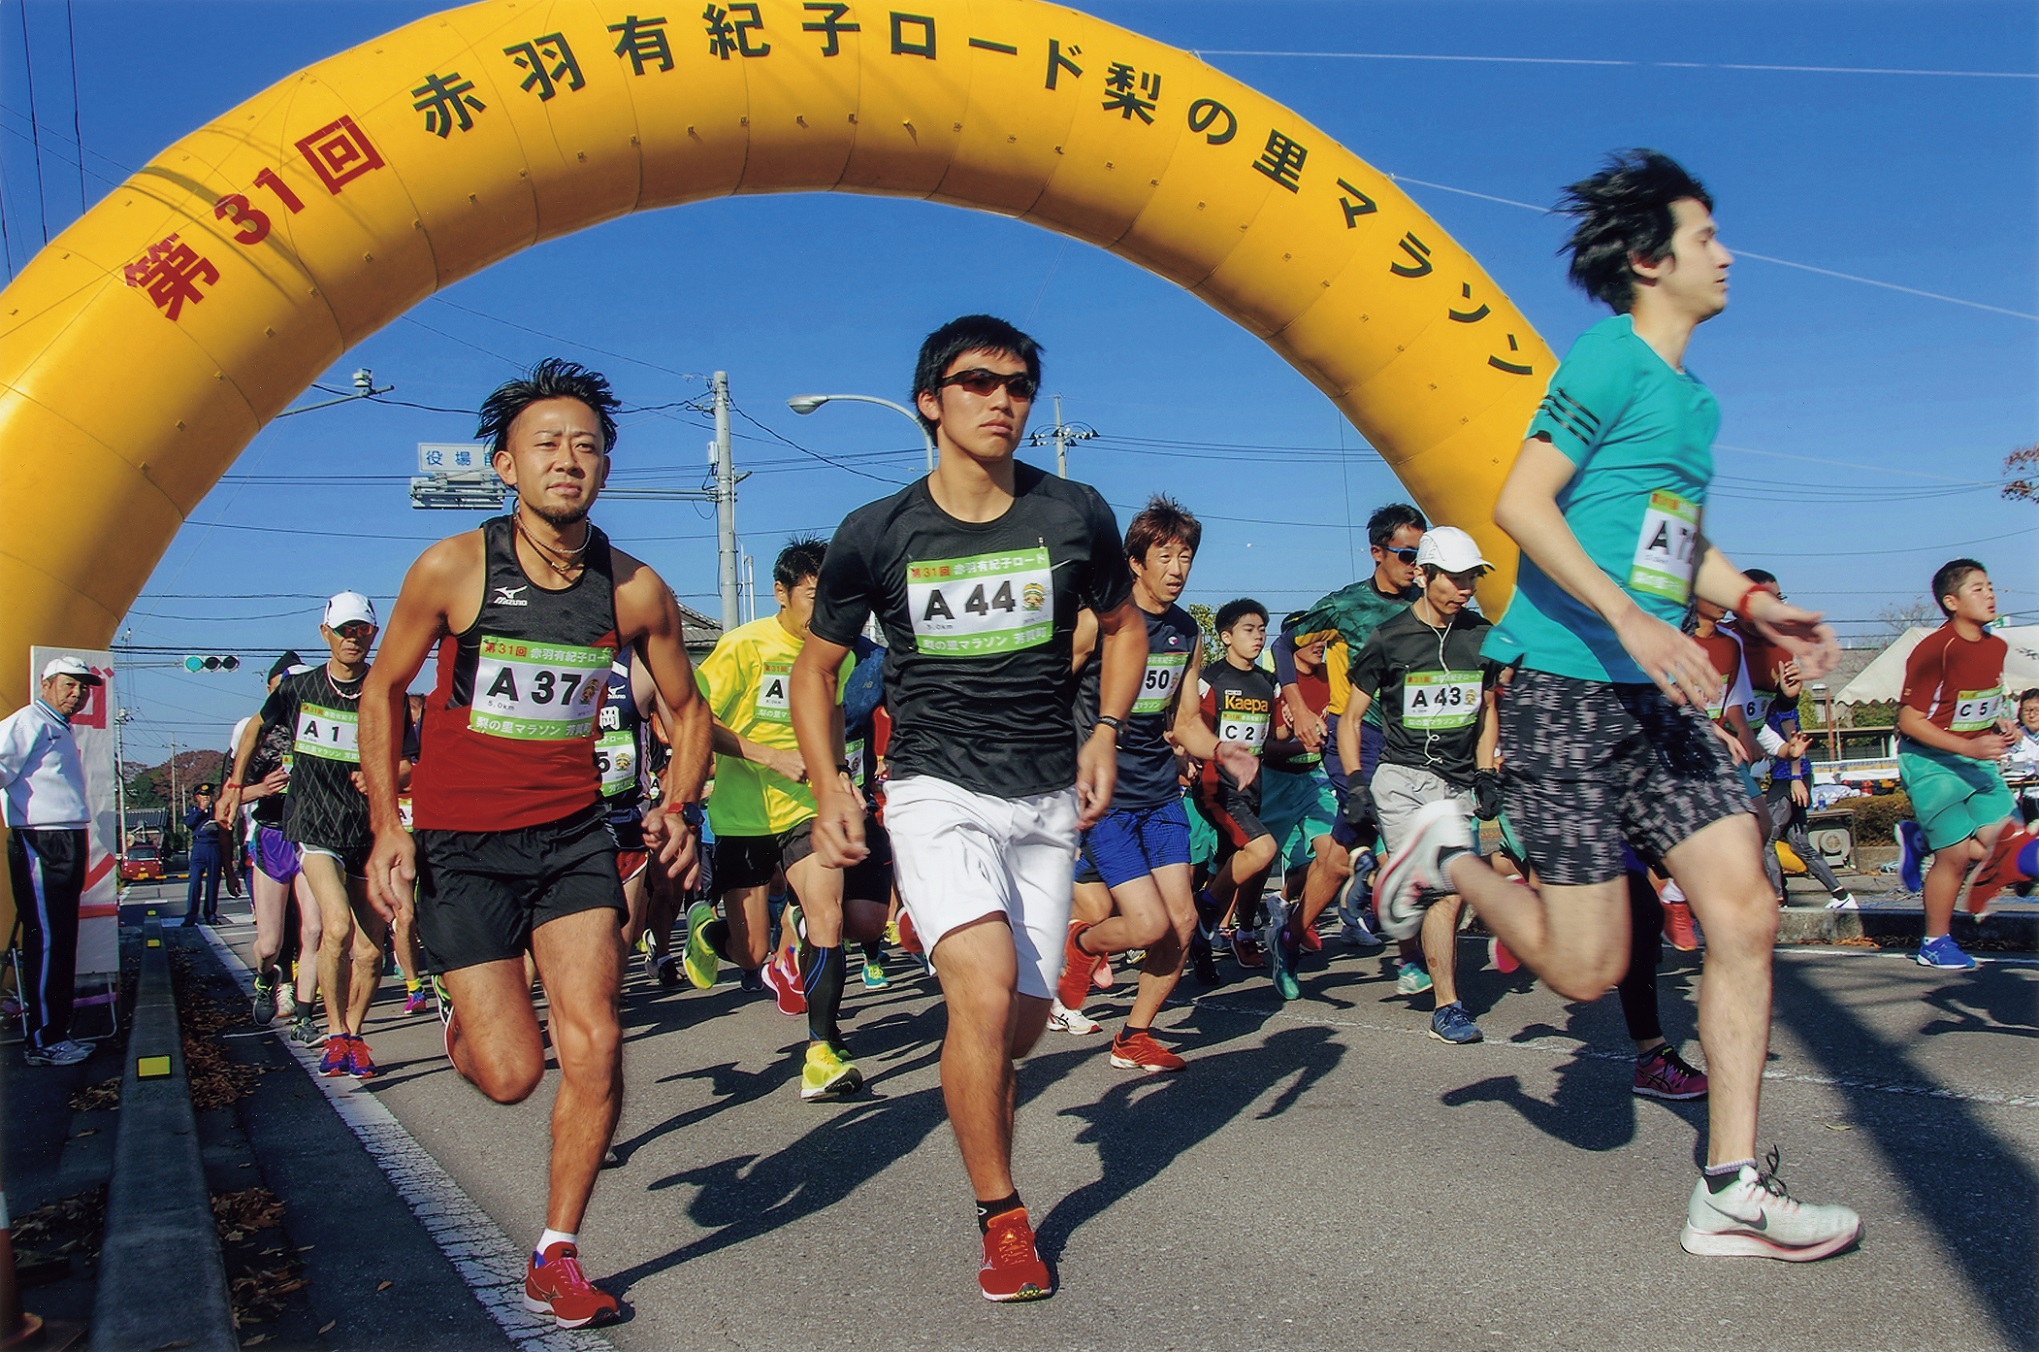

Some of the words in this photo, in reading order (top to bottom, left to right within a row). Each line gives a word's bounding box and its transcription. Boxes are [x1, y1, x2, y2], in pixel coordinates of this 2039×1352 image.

[124, 114, 385, 321] 第31回
[923, 589, 955, 621] A
[965, 580, 1016, 616] 44
[484, 641, 527, 657] 第31回
[486, 667, 519, 701] A
[531, 670, 582, 706] 37
[765, 678, 784, 699] A
[1146, 669, 1170, 690] 50
[1225, 695, 1269, 714] Kaepa
[1412, 690, 1429, 708] A
[1434, 687, 1462, 706] 43
[1960, 703, 1973, 717] C
[1979, 701, 1989, 716] 5
[303, 720, 319, 738] A
[332, 726, 340, 742] 1
[1225, 725, 1238, 740] C
[1244, 726, 1255, 741] 2
